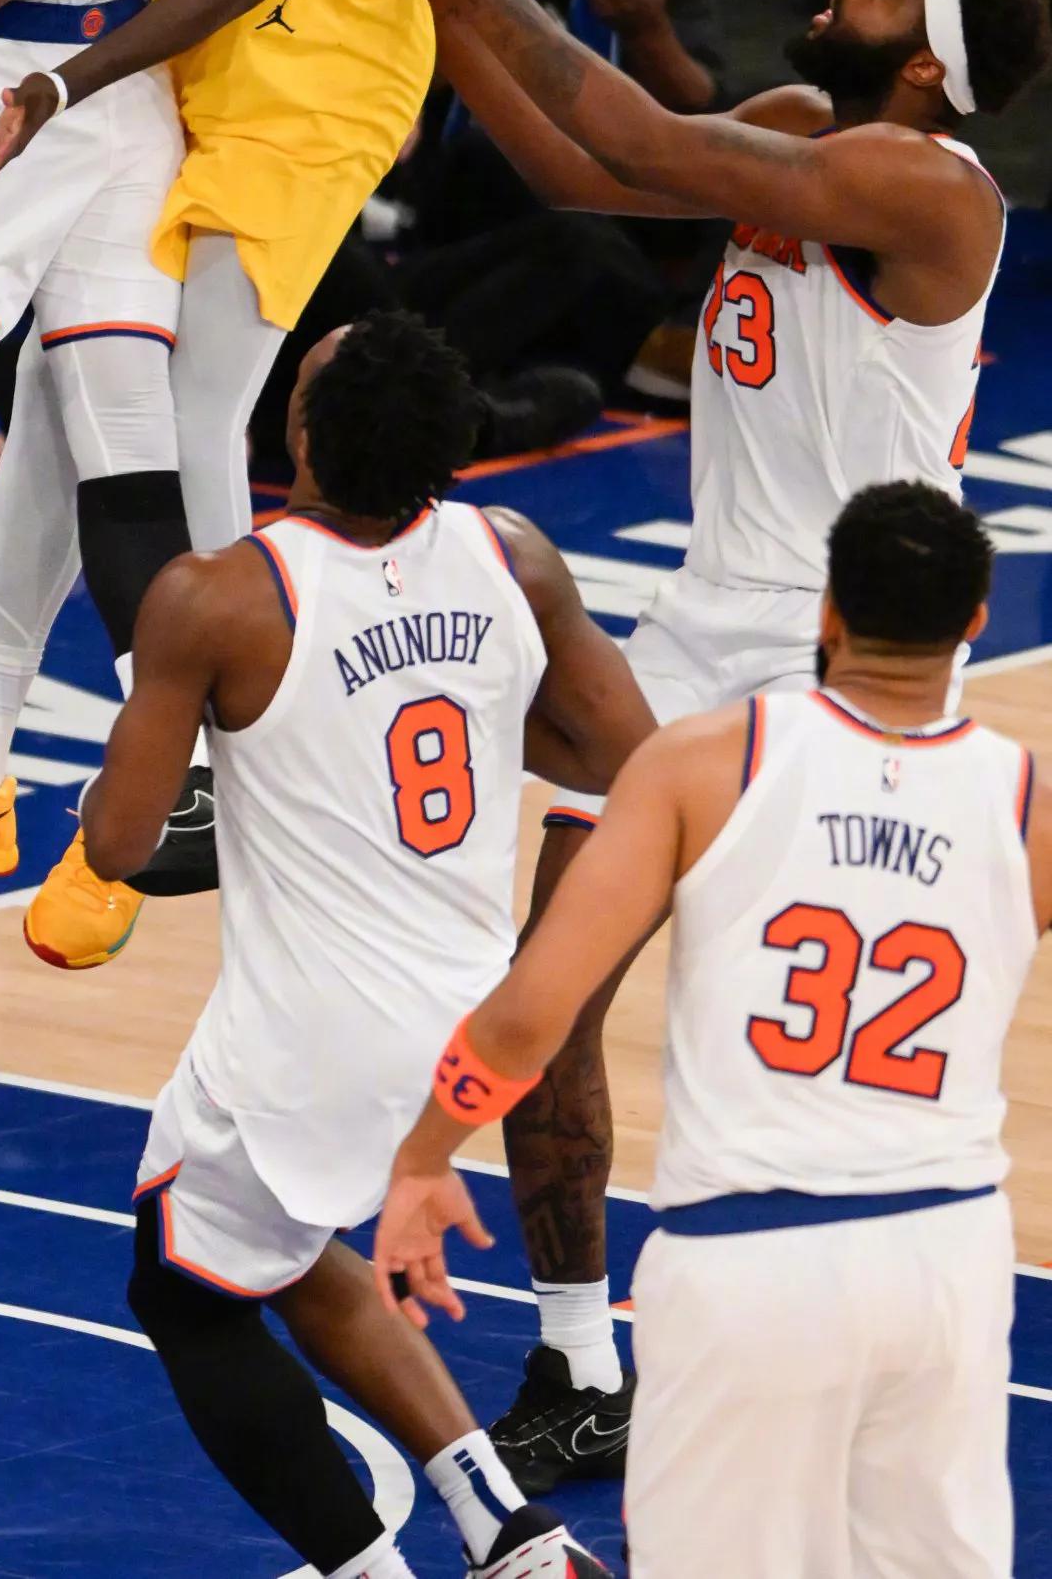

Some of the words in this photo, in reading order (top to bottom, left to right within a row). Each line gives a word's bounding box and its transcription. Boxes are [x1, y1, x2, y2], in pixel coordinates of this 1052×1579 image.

[334, 611, 493, 697] ANUNOBY
[385, 694, 476, 859] 8
[818, 813, 952, 886] TOWNS
[746, 902, 967, 1101] 32
